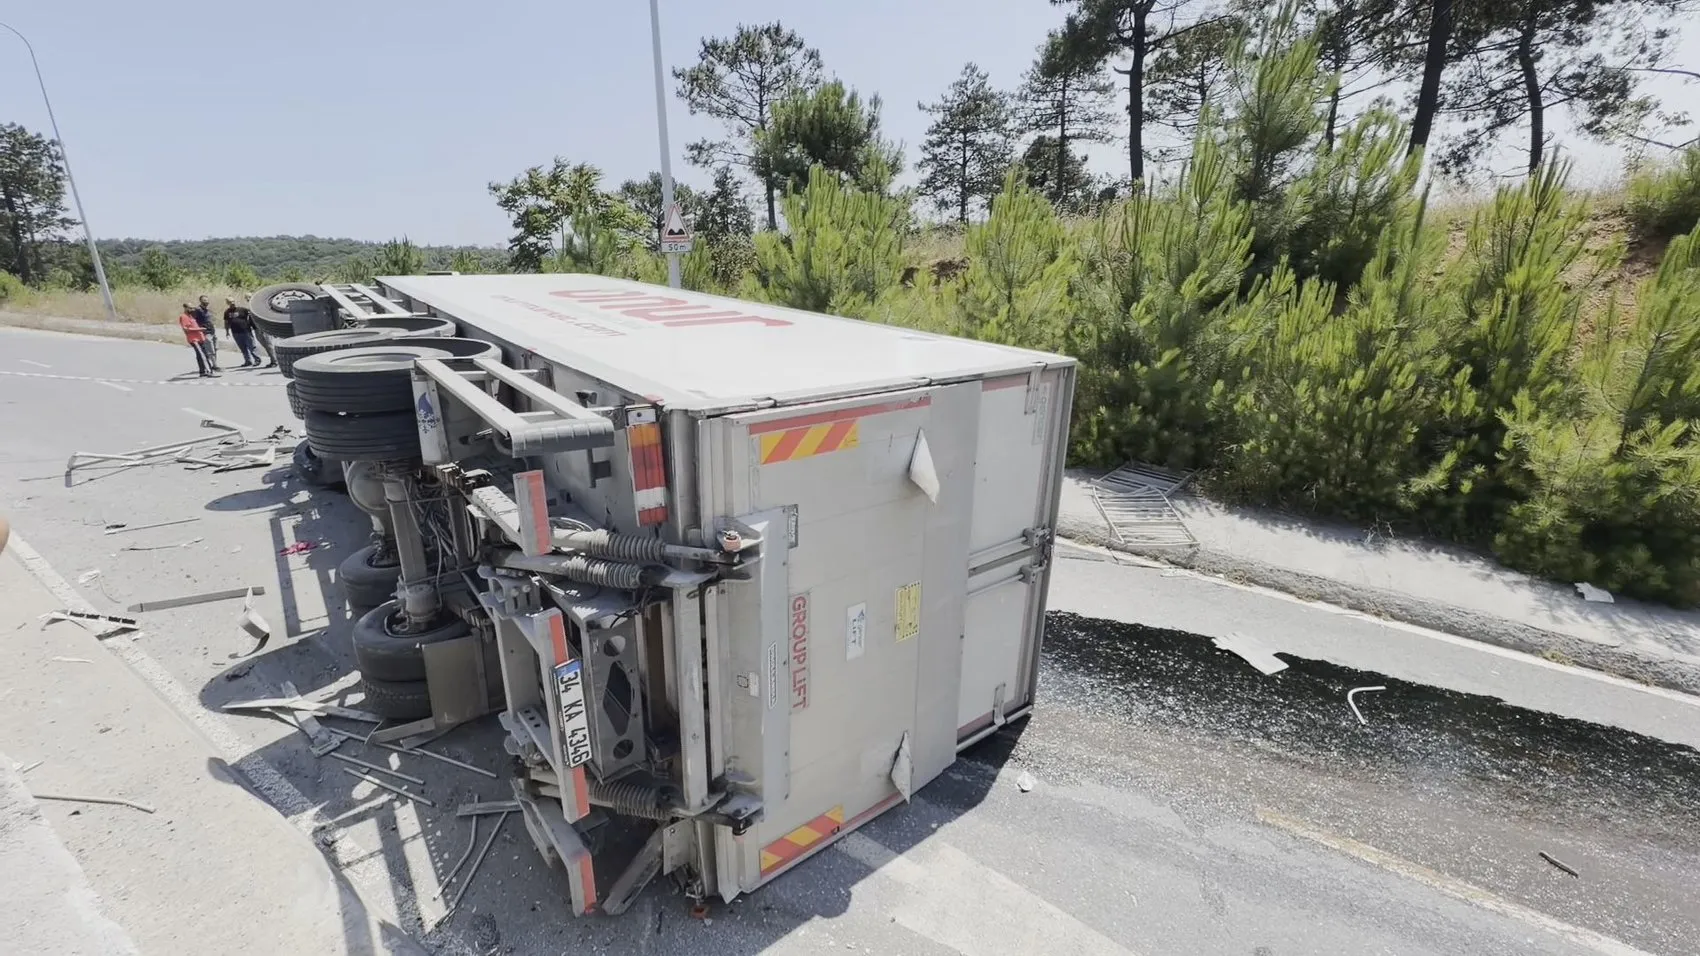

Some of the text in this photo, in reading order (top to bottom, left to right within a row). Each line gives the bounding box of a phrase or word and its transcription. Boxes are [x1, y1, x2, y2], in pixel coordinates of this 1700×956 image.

[792, 596, 807, 665] GROUP
[560, 671, 590, 764] 34 KA 4346
